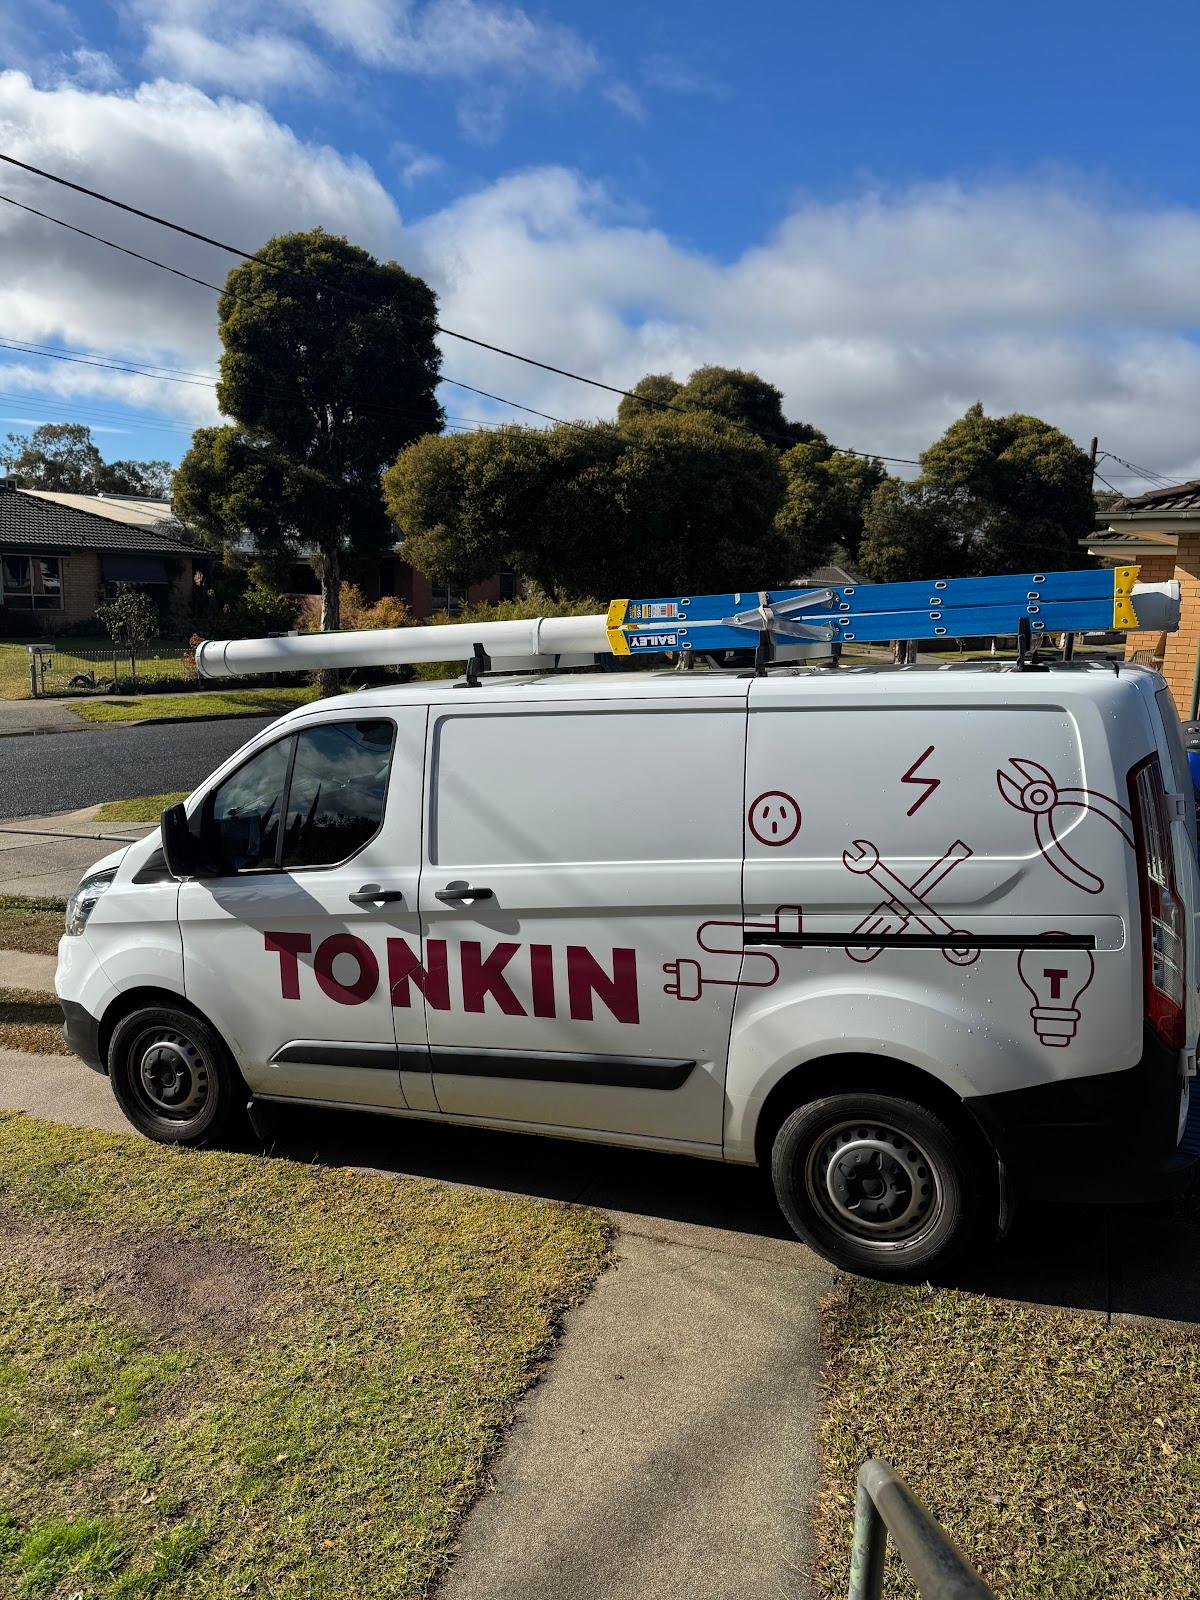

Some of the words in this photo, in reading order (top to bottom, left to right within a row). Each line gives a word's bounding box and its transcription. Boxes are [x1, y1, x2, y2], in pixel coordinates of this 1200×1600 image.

[631, 635, 676, 647] BAILEY
[264, 931, 640, 1025] TONKIN
[1043, 968, 1068, 999] T
